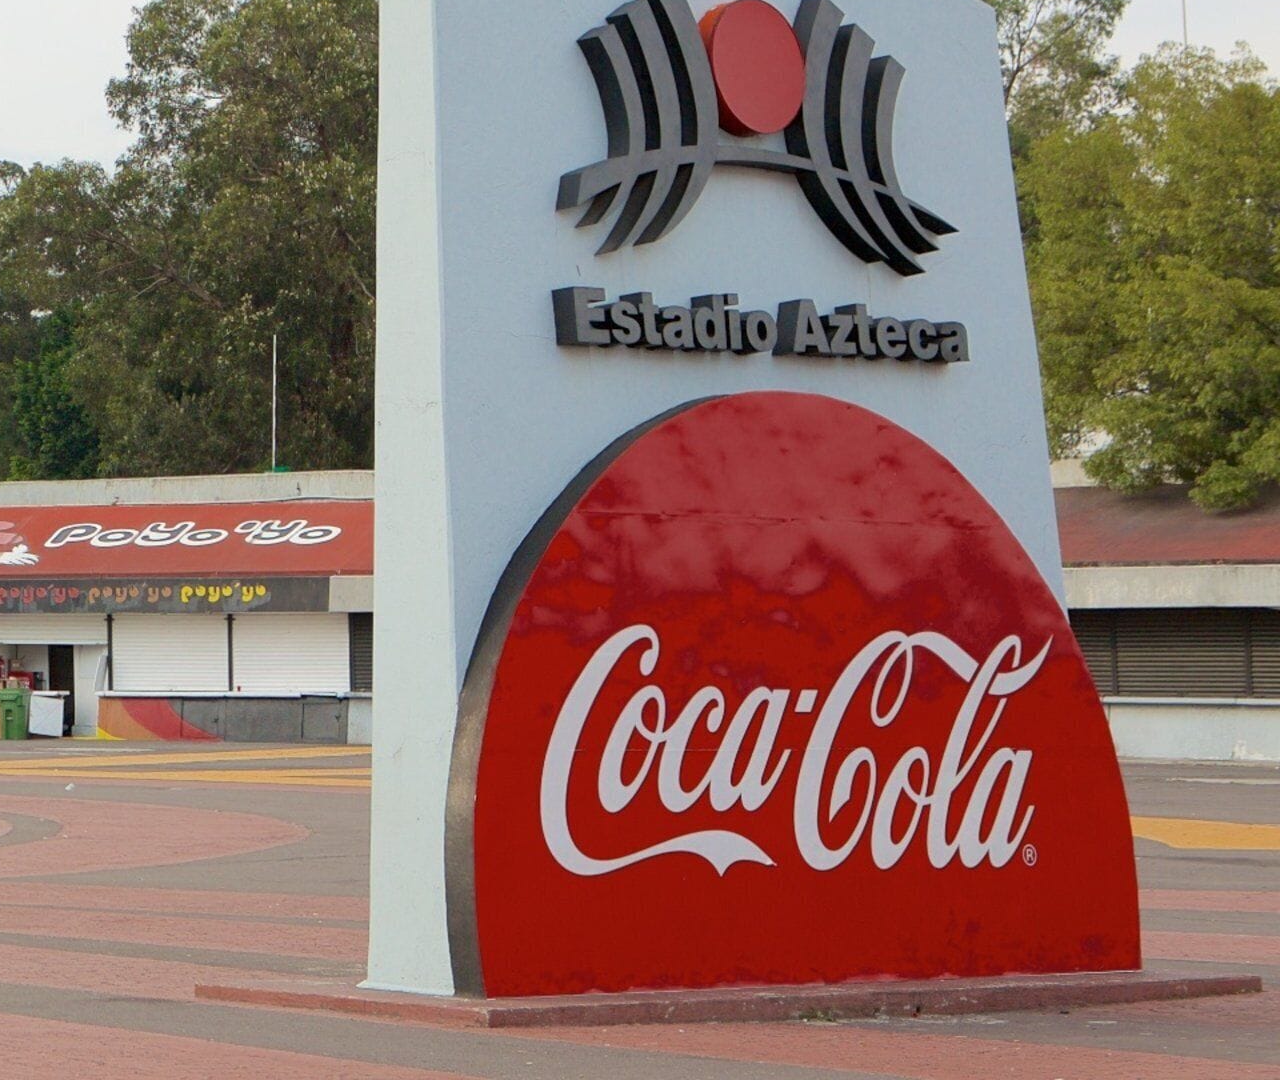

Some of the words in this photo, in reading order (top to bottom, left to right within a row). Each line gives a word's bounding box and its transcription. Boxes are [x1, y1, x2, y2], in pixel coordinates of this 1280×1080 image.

[552, 286, 779, 353] Estadio
[772, 298, 970, 362] Azteca
[540, 624, 1053, 877] Coca-Cola
